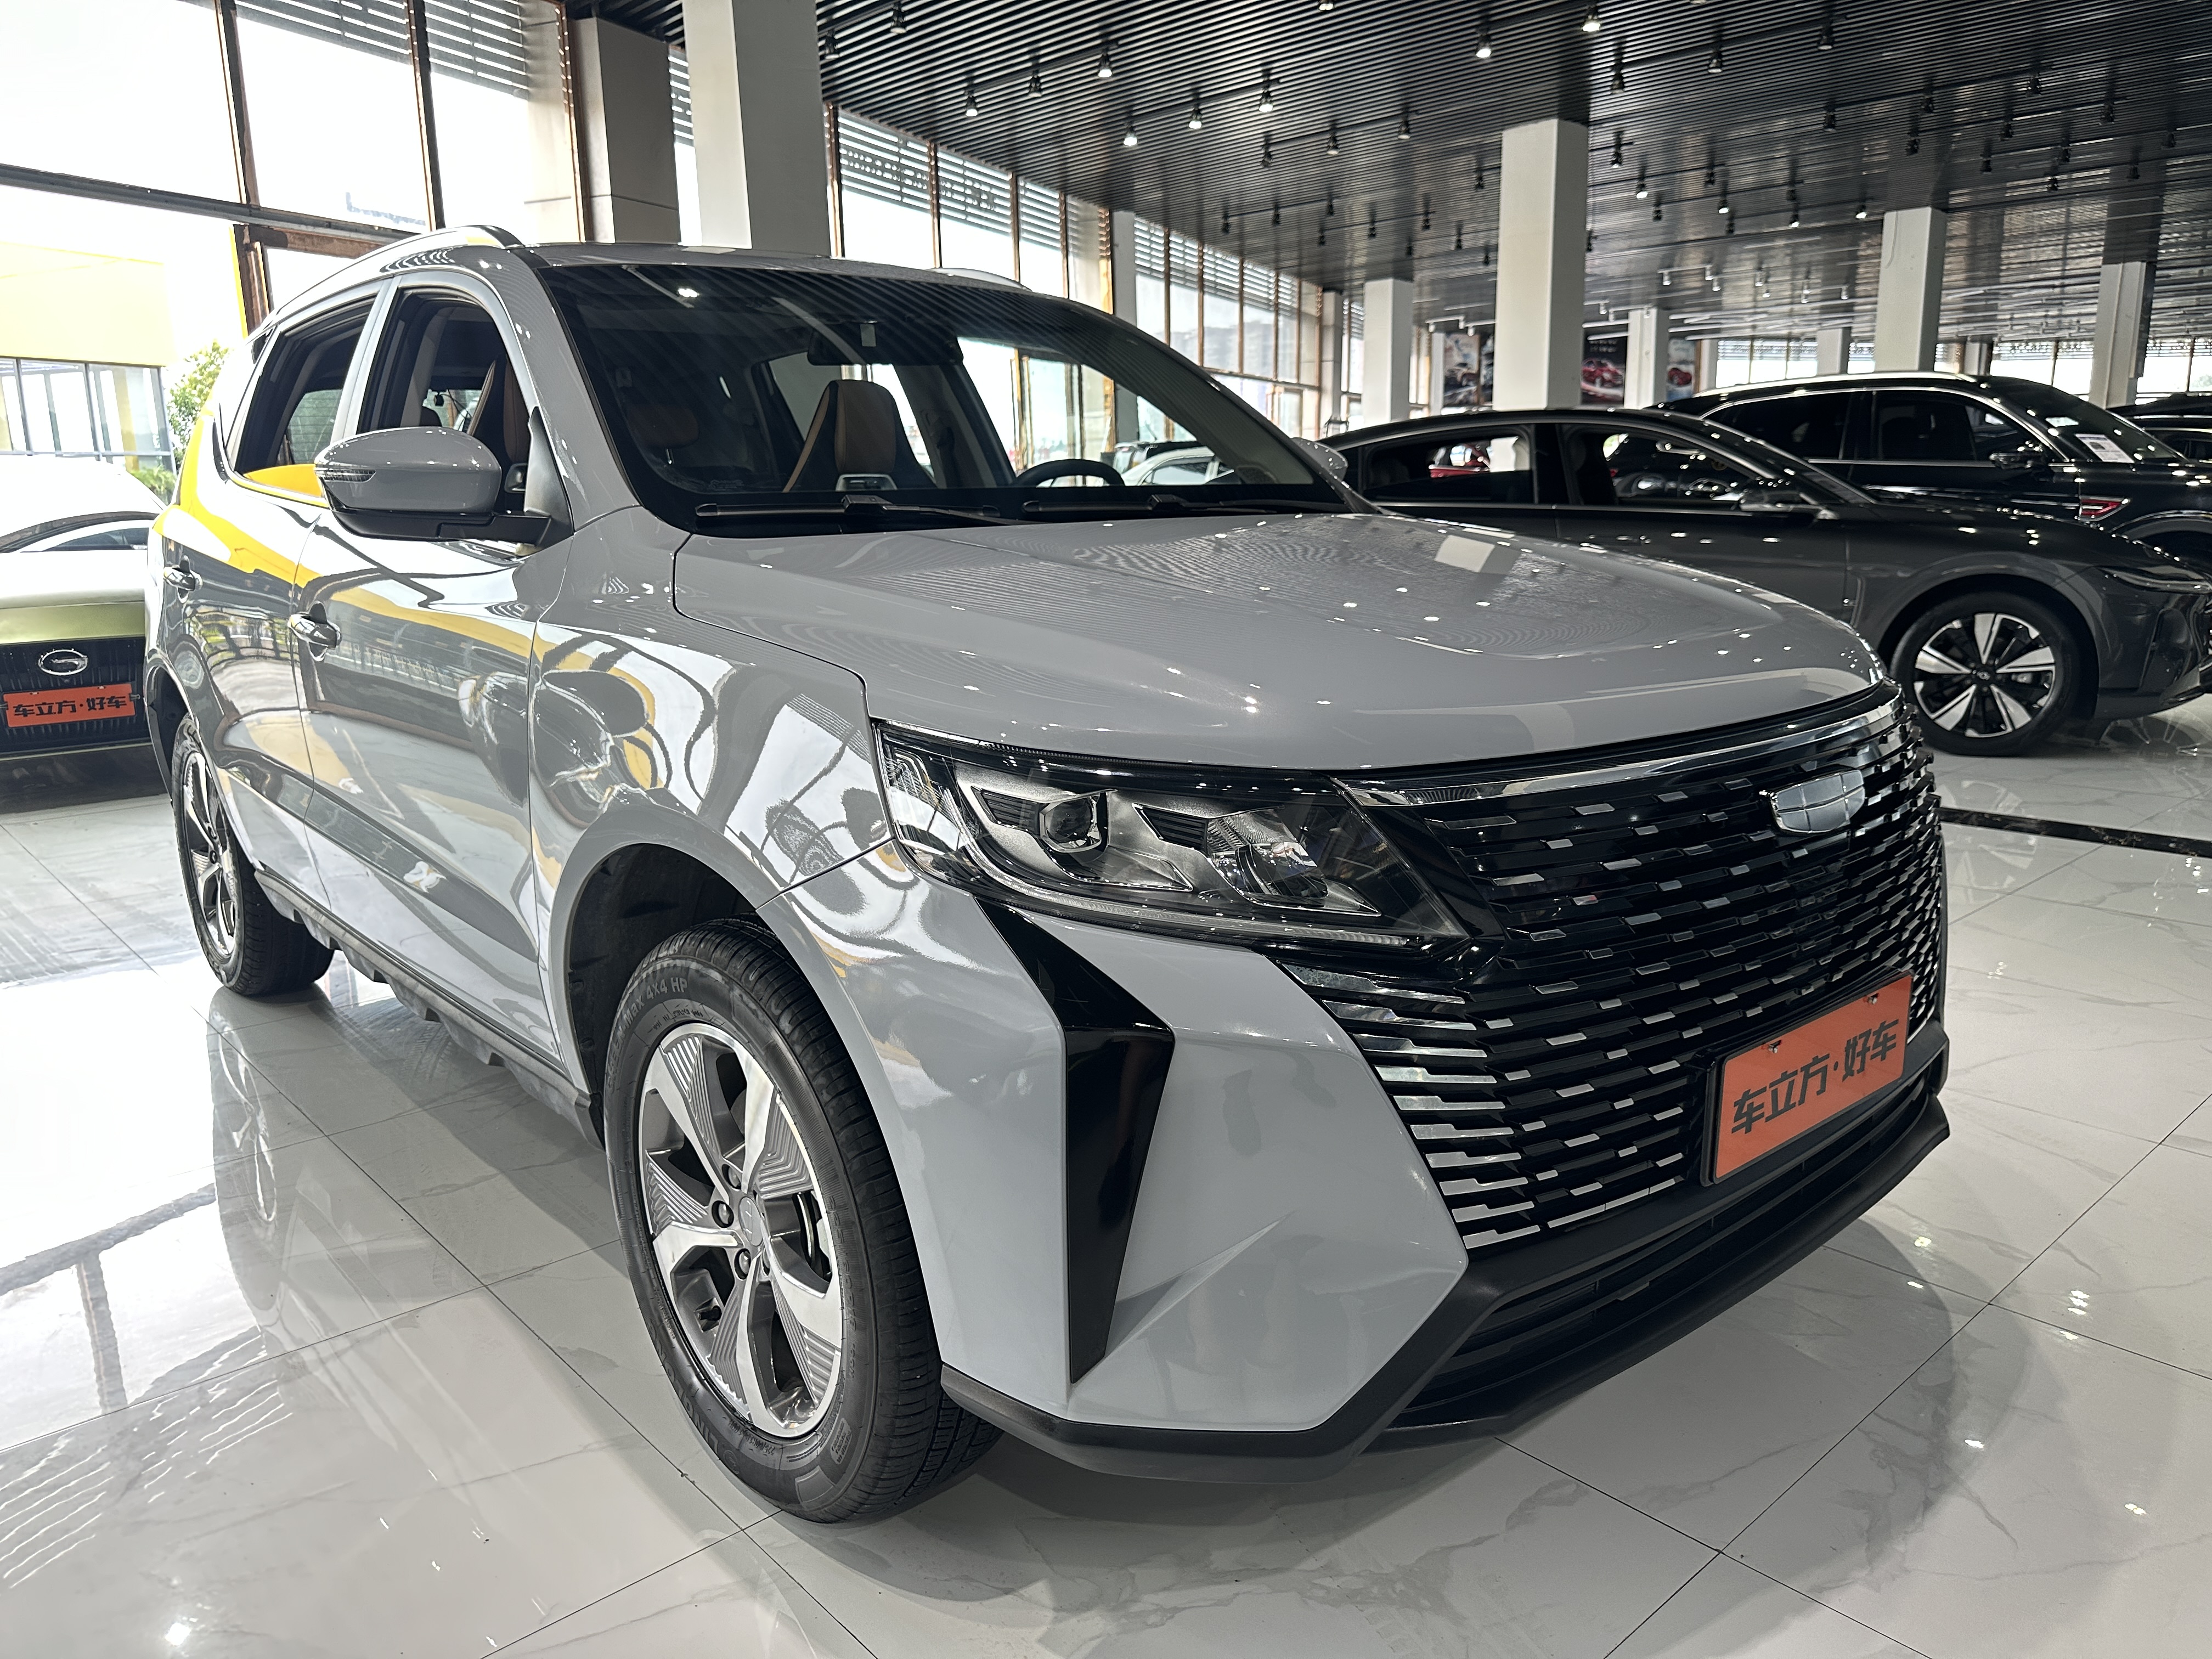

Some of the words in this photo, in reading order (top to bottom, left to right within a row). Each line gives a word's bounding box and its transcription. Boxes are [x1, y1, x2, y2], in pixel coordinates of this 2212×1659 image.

[13, 696, 127, 717] 车立方·好车
[670, 977, 688, 993] HP
[1731, 1019, 1899, 1135] 车立方·好车
